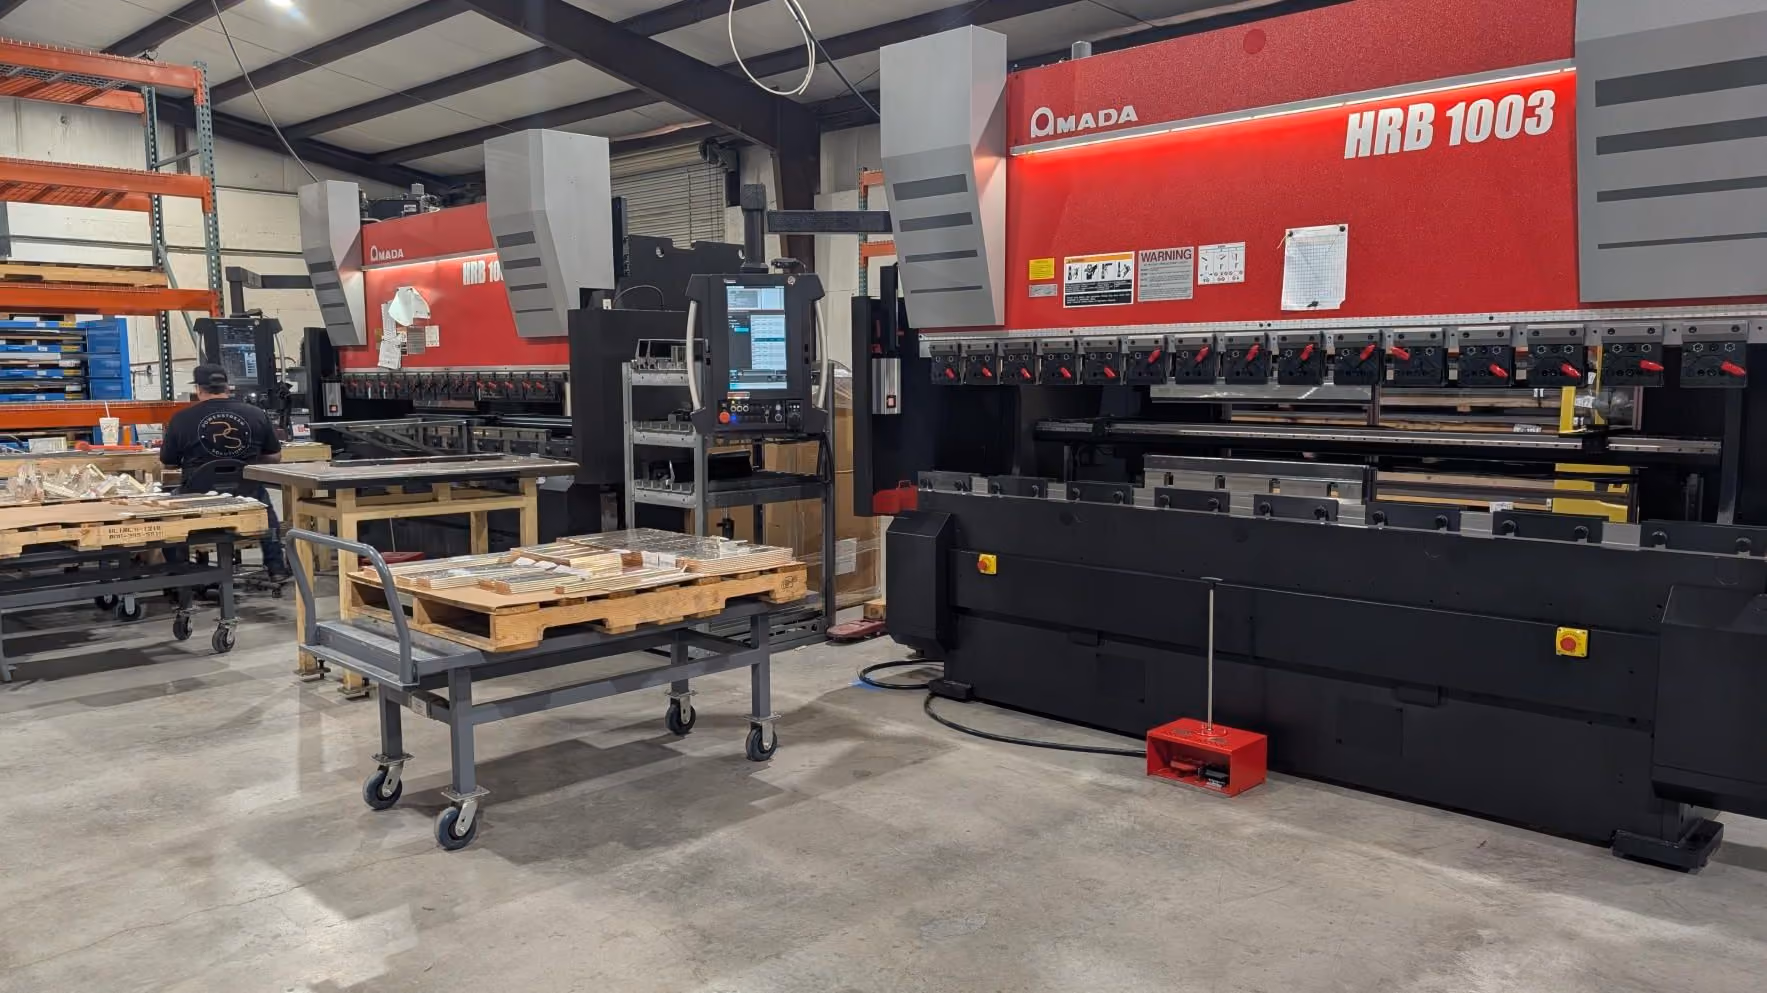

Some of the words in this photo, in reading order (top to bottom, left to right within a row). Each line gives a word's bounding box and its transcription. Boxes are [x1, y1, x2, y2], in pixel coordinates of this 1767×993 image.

[1344, 103, 1435, 159] HRB
[1446, 90, 1555, 145] 1003
[1140, 249, 1192, 262] WARNING
[463, 260, 486, 285] HRB
